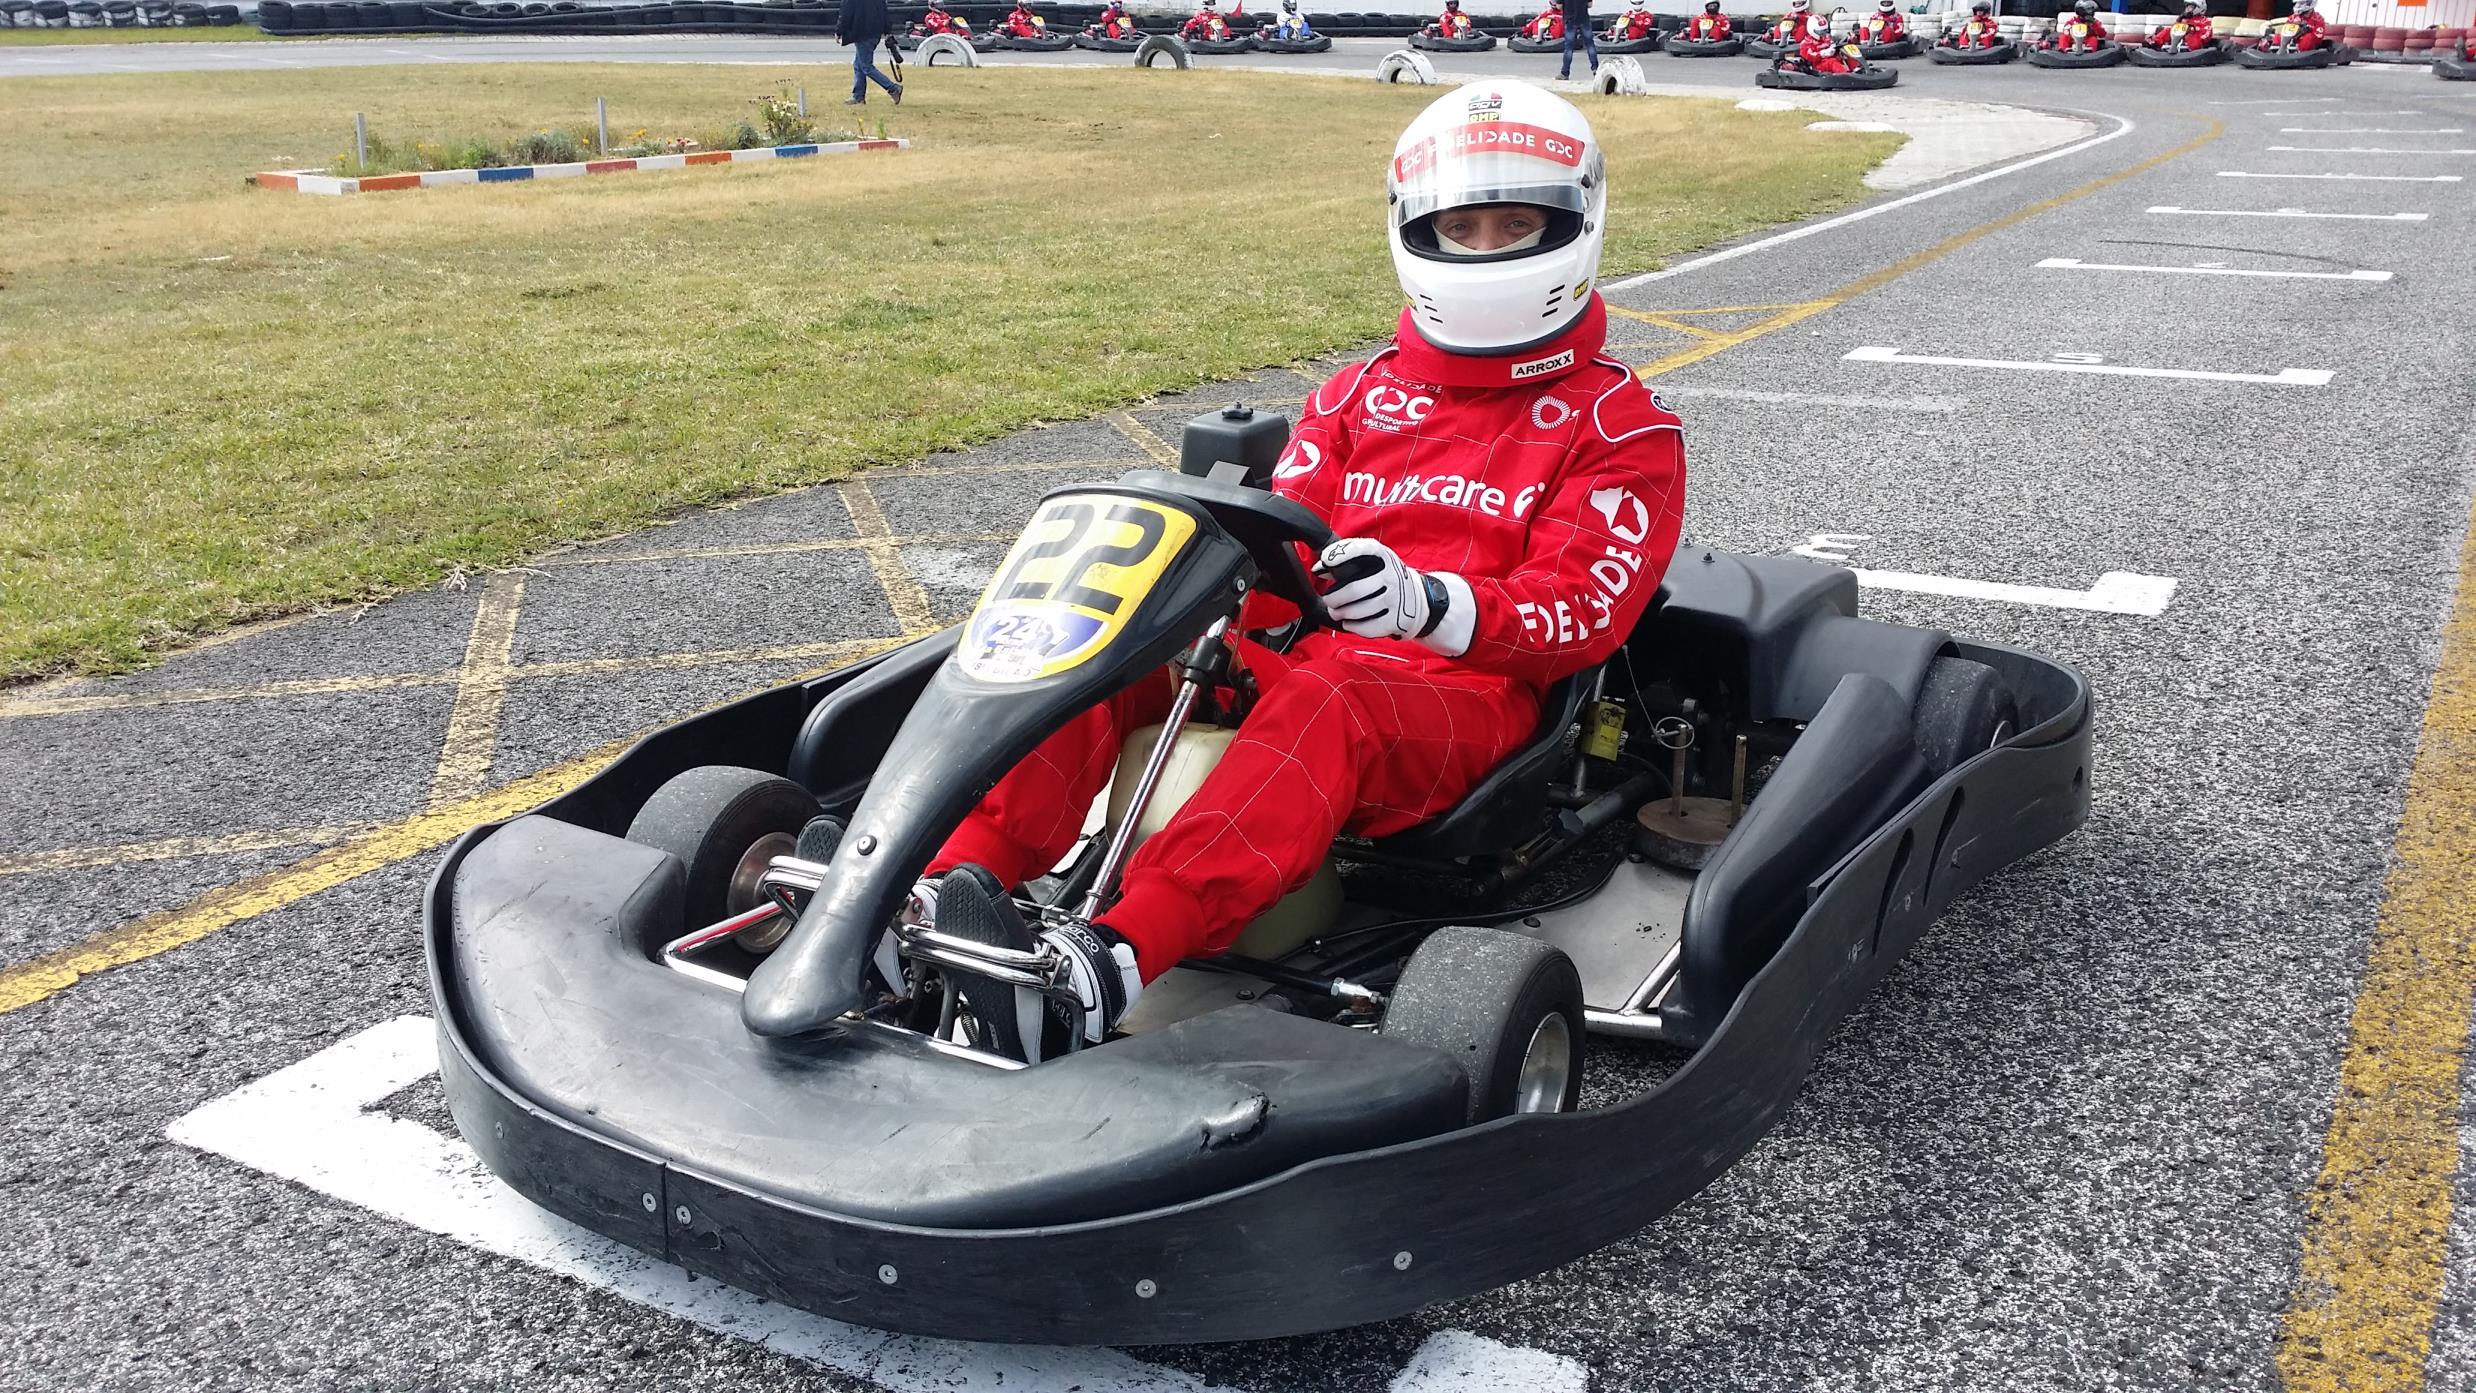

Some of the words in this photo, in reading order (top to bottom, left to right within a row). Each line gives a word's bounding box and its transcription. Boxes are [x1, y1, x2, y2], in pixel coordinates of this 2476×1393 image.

[1515, 354, 1572, 376] ARROXX
[1343, 472, 1506, 516] multicare
[992, 503, 1166, 615] 22
